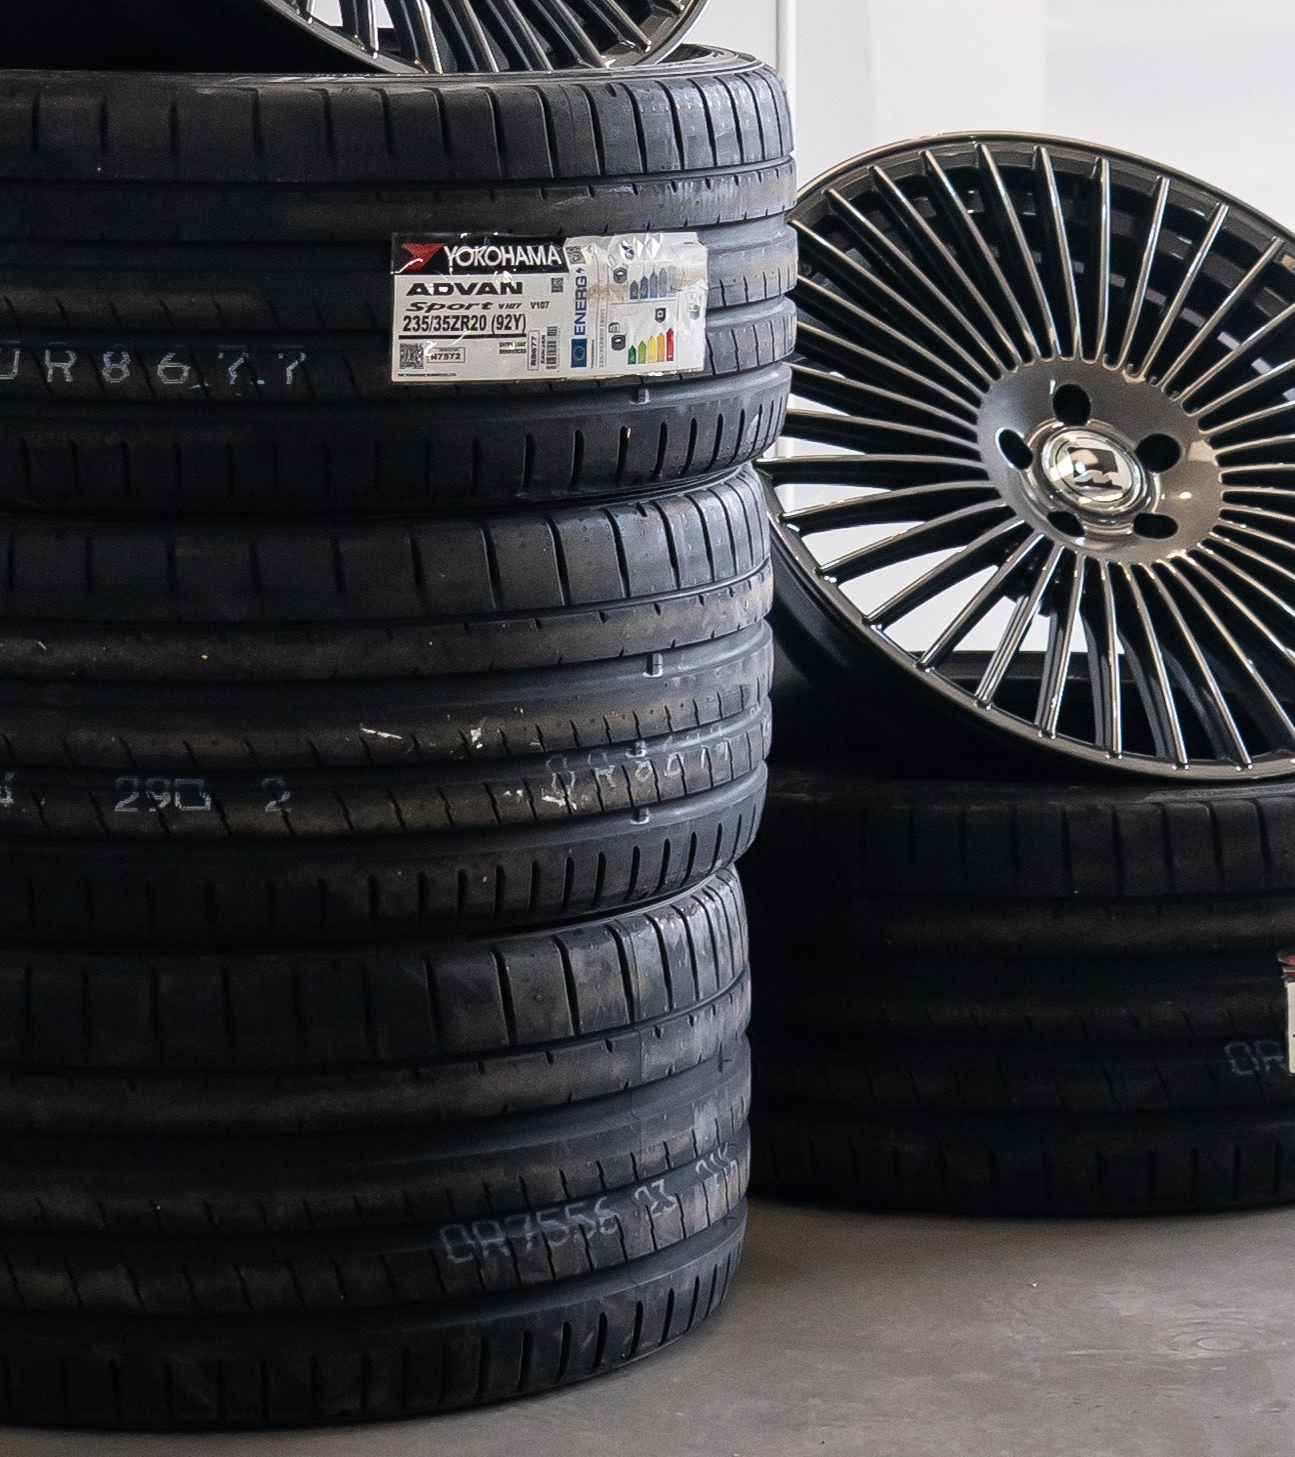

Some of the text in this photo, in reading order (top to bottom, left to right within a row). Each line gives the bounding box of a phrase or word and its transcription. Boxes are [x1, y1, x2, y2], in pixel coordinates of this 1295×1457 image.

[444, 245, 563, 267] YOKOHAMA
[405, 281, 524, 296] ADVAN
[405, 301, 494, 313] Sport
[530, 301, 551, 310] V107
[574, 275, 588, 336] ENERG
[402, 313, 527, 334] 235/35ZR20 (92Y)
